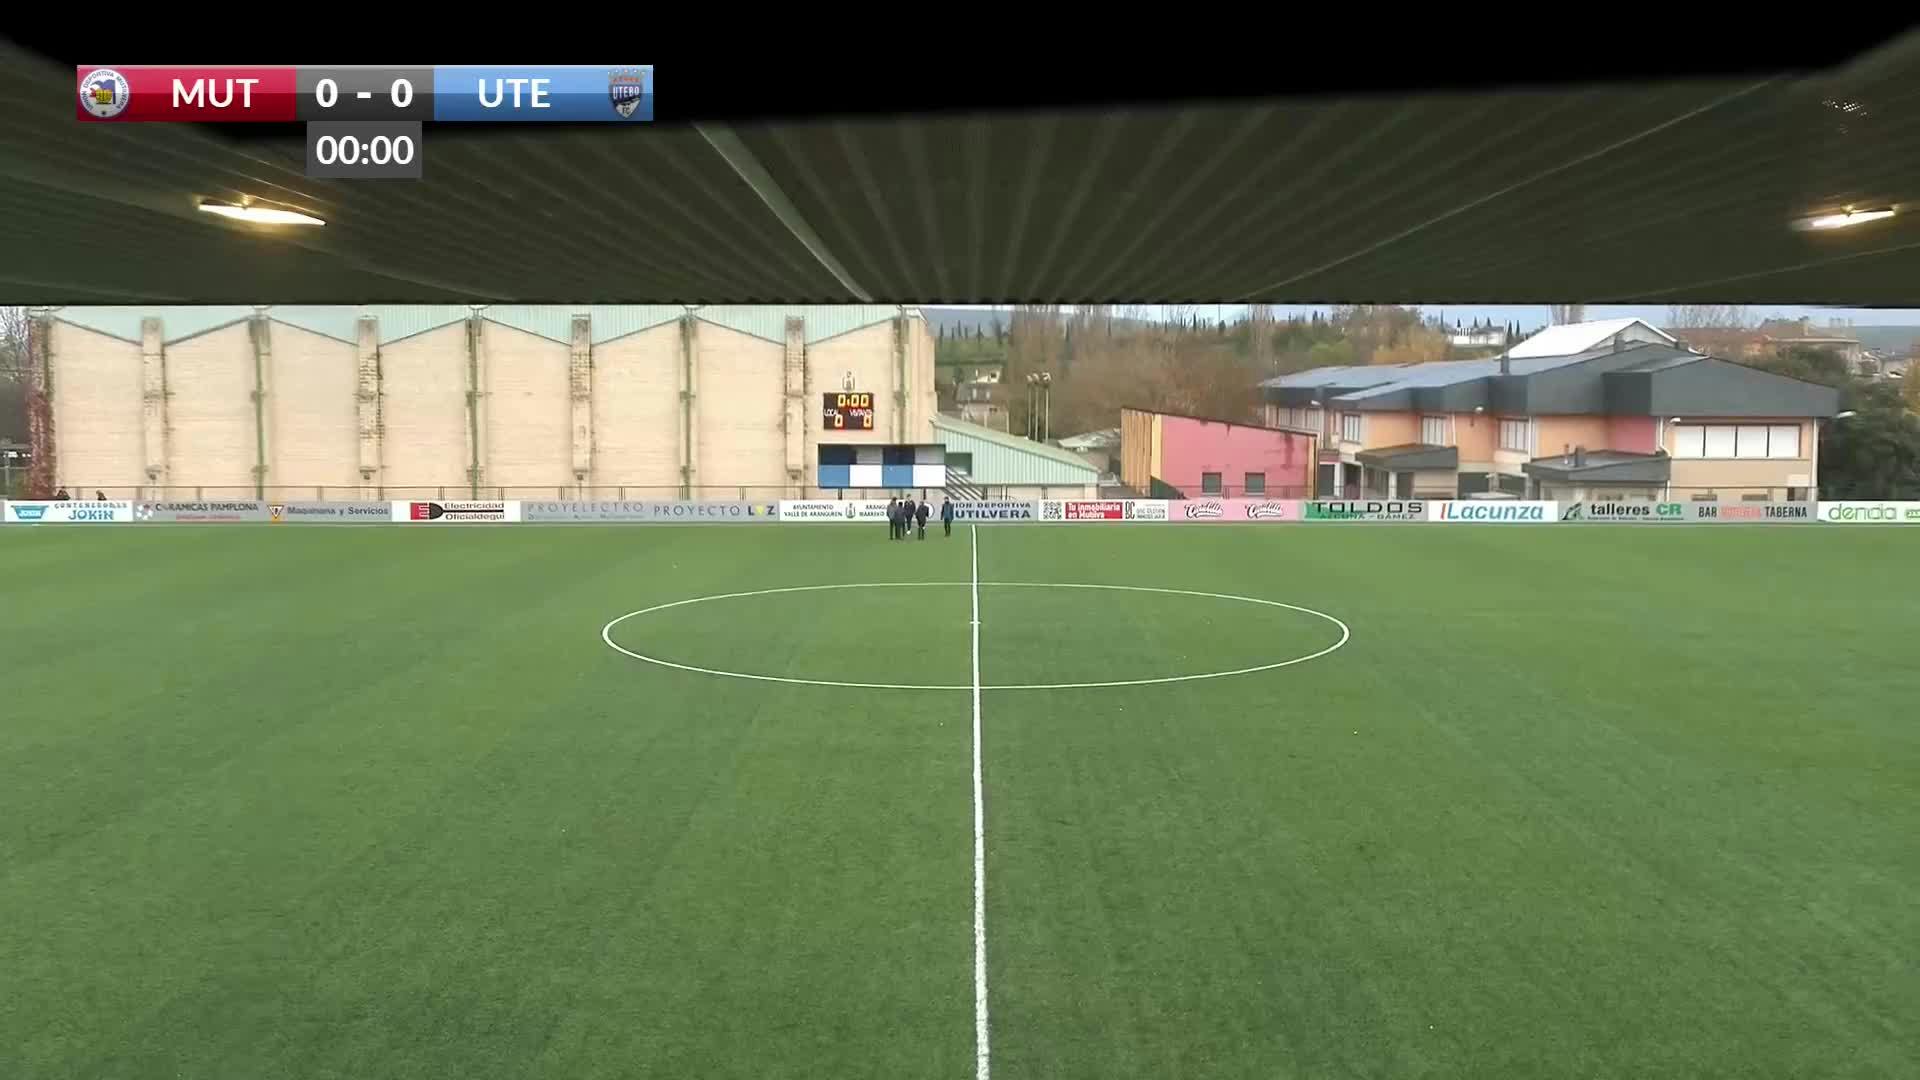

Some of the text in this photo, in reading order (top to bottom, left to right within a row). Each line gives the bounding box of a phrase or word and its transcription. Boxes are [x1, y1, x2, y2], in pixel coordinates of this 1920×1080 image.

[835, 415, 843, 427] 0
[210, 503, 258, 511] PAMPLONA
[347, 506, 389, 515] Servicios
[528, 502, 644, 512] PROYELECTRO
[653, 505, 740, 516] PROYECTO
[1312, 502, 1422, 513] TOLDOS
[1591, 503, 1682, 515] talleres CR
[1698, 507, 1717, 517] BAR
[1765, 506, 1807, 517] TABERNA
[1828, 503, 1897, 520] denda
